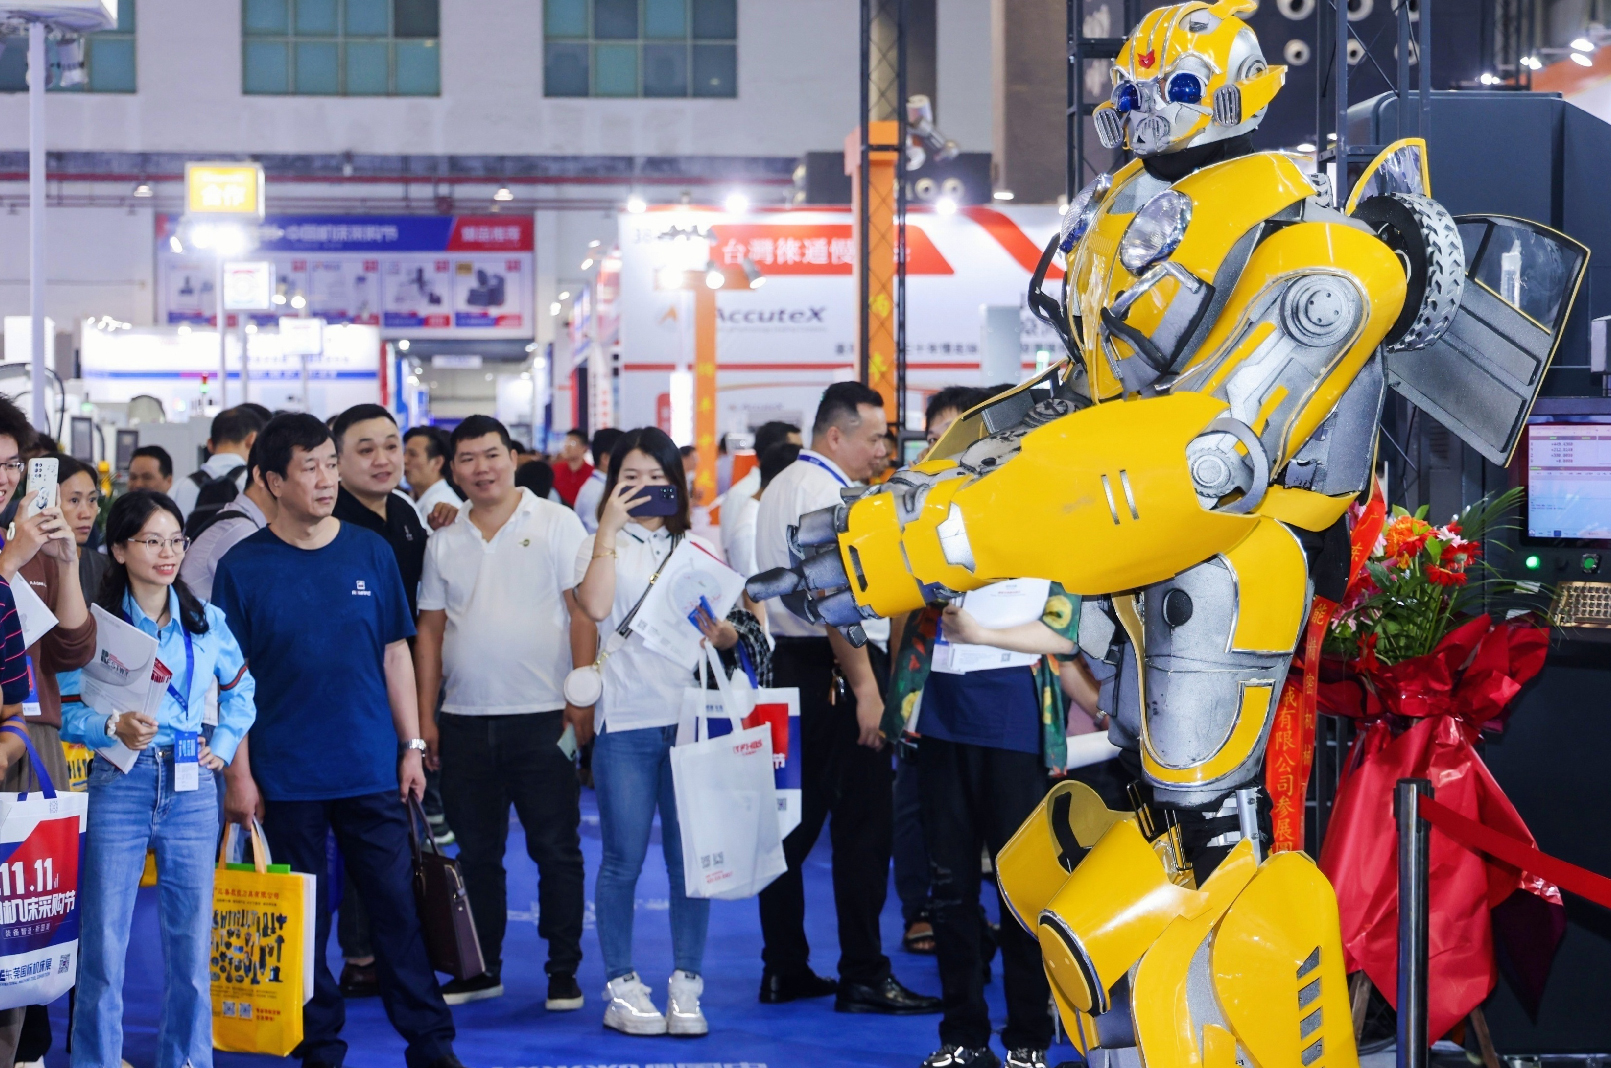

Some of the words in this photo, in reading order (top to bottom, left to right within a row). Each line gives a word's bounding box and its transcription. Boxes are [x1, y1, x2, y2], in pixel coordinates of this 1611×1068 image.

[0, 890, 76, 925] 机床采购节
